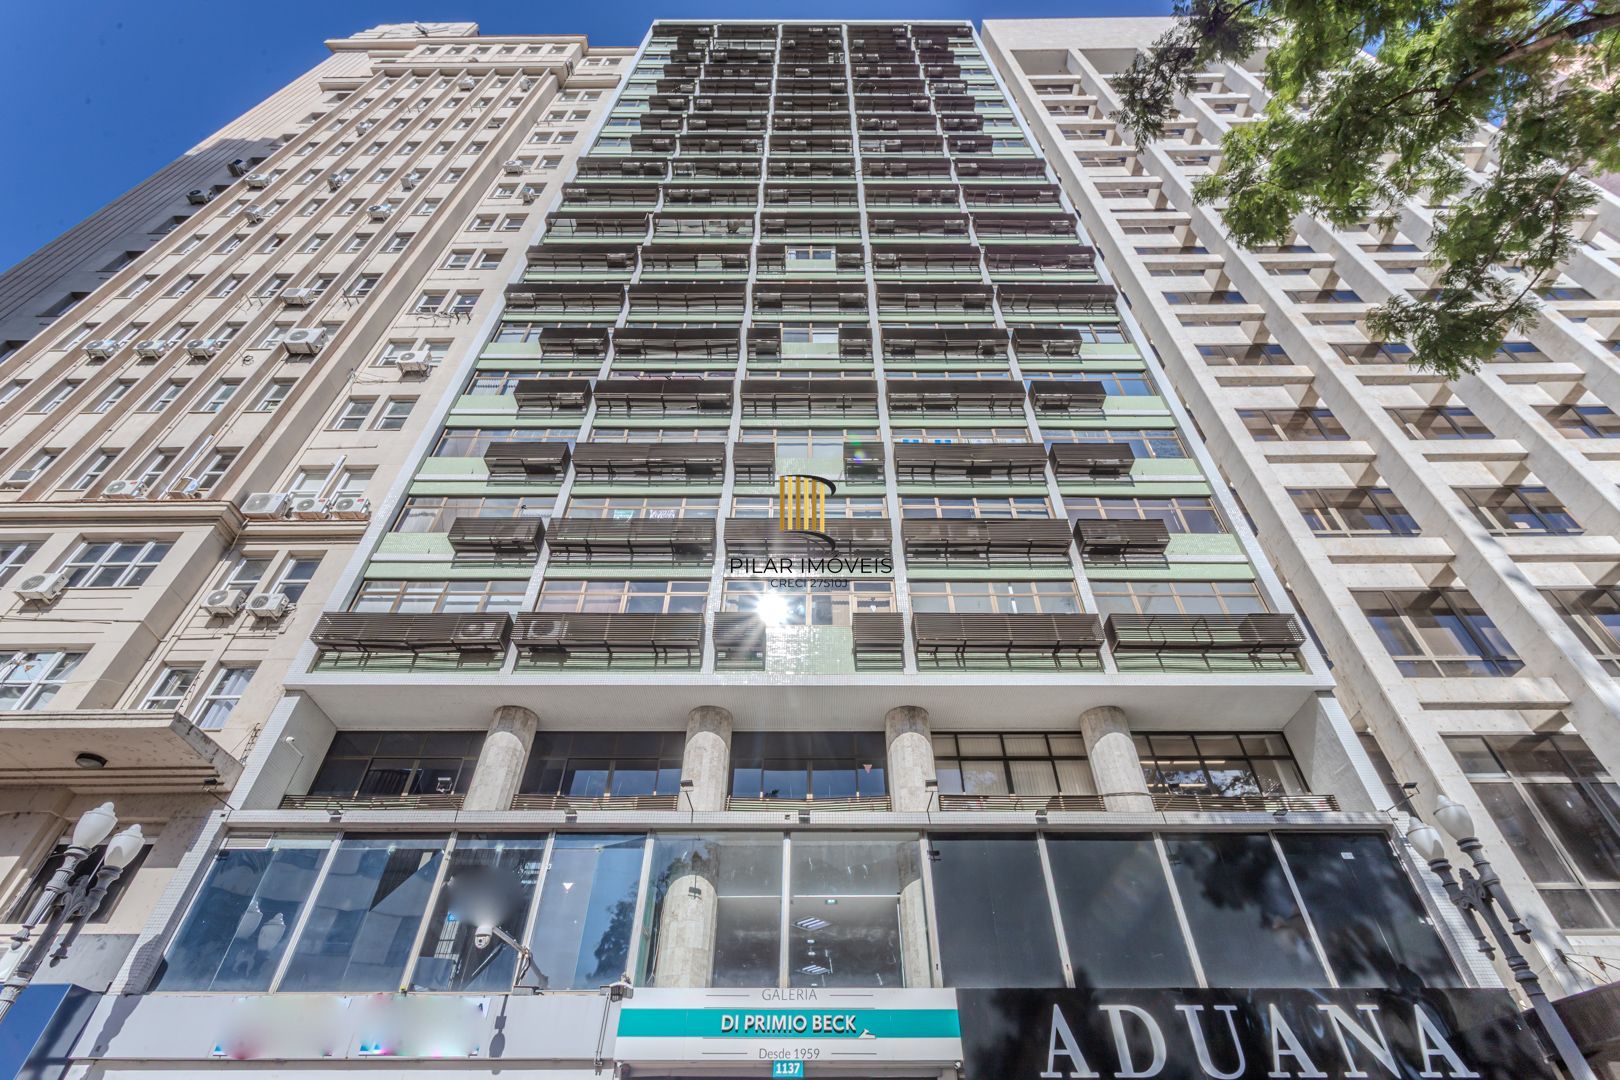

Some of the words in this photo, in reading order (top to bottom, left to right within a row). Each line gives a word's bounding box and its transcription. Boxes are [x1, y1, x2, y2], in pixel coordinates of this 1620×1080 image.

[761, 988, 818, 1001] GALERIA
[721, 1014, 739, 1033] DI
[744, 1014, 807, 1033] PRIMIO
[812, 1014, 857, 1033] BECK
[1039, 1003, 1481, 1079] ADUANA
[758, 1048, 791, 1059] Desde
[794, 1048, 820, 1059] 1959
[775, 1062, 801, 1075] 1137
